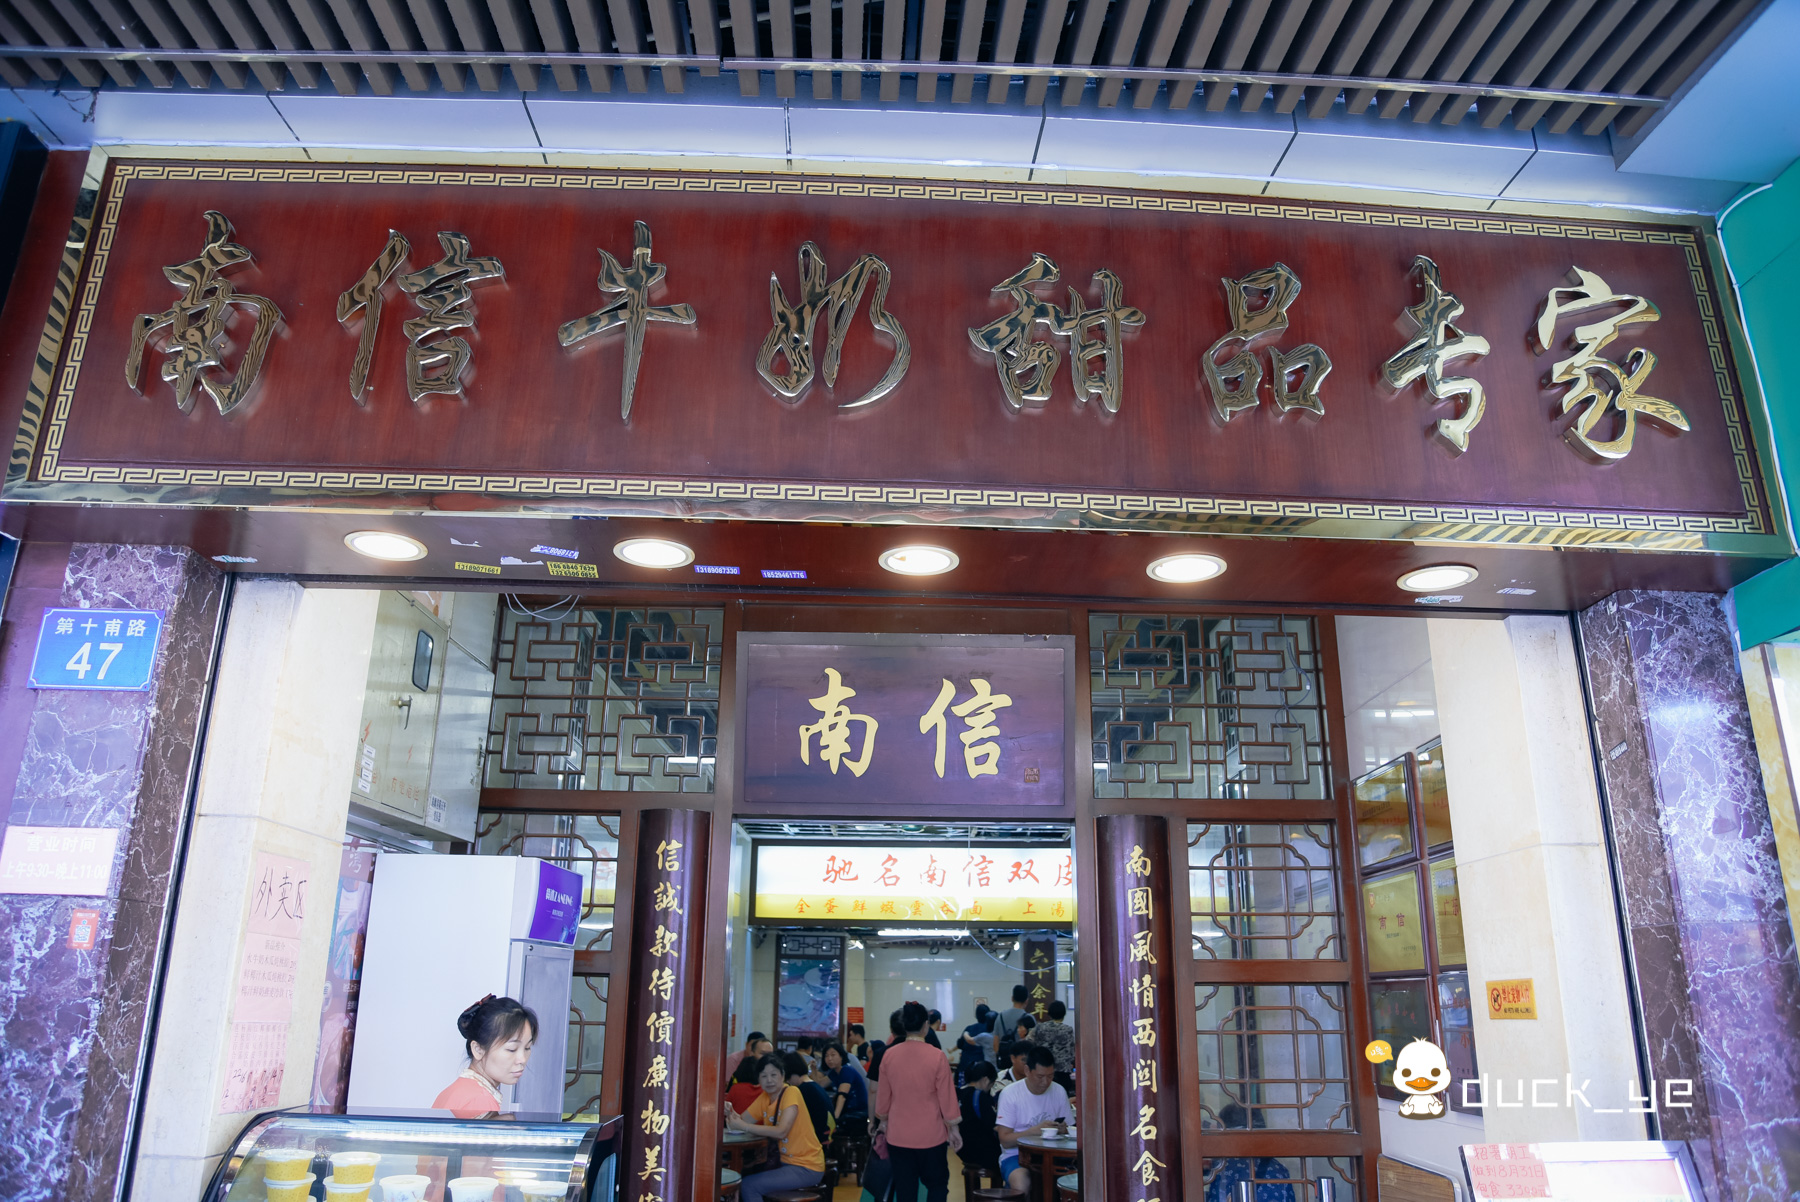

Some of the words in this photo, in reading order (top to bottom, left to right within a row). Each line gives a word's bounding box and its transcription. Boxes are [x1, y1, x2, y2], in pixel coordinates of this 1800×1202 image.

[124, 209, 1693, 460] 南信牛奶甜品专家
[54, 616, 147, 638] 第十甫路
[65, 642, 123, 681] 47
[798, 667, 1013, 780] 南信
[26, 834, 97, 854] 营业时间
[1125, 845, 1167, 1202] 南國風情西關名食
[1472, 1164, 1545, 1178] 做到8月31日
